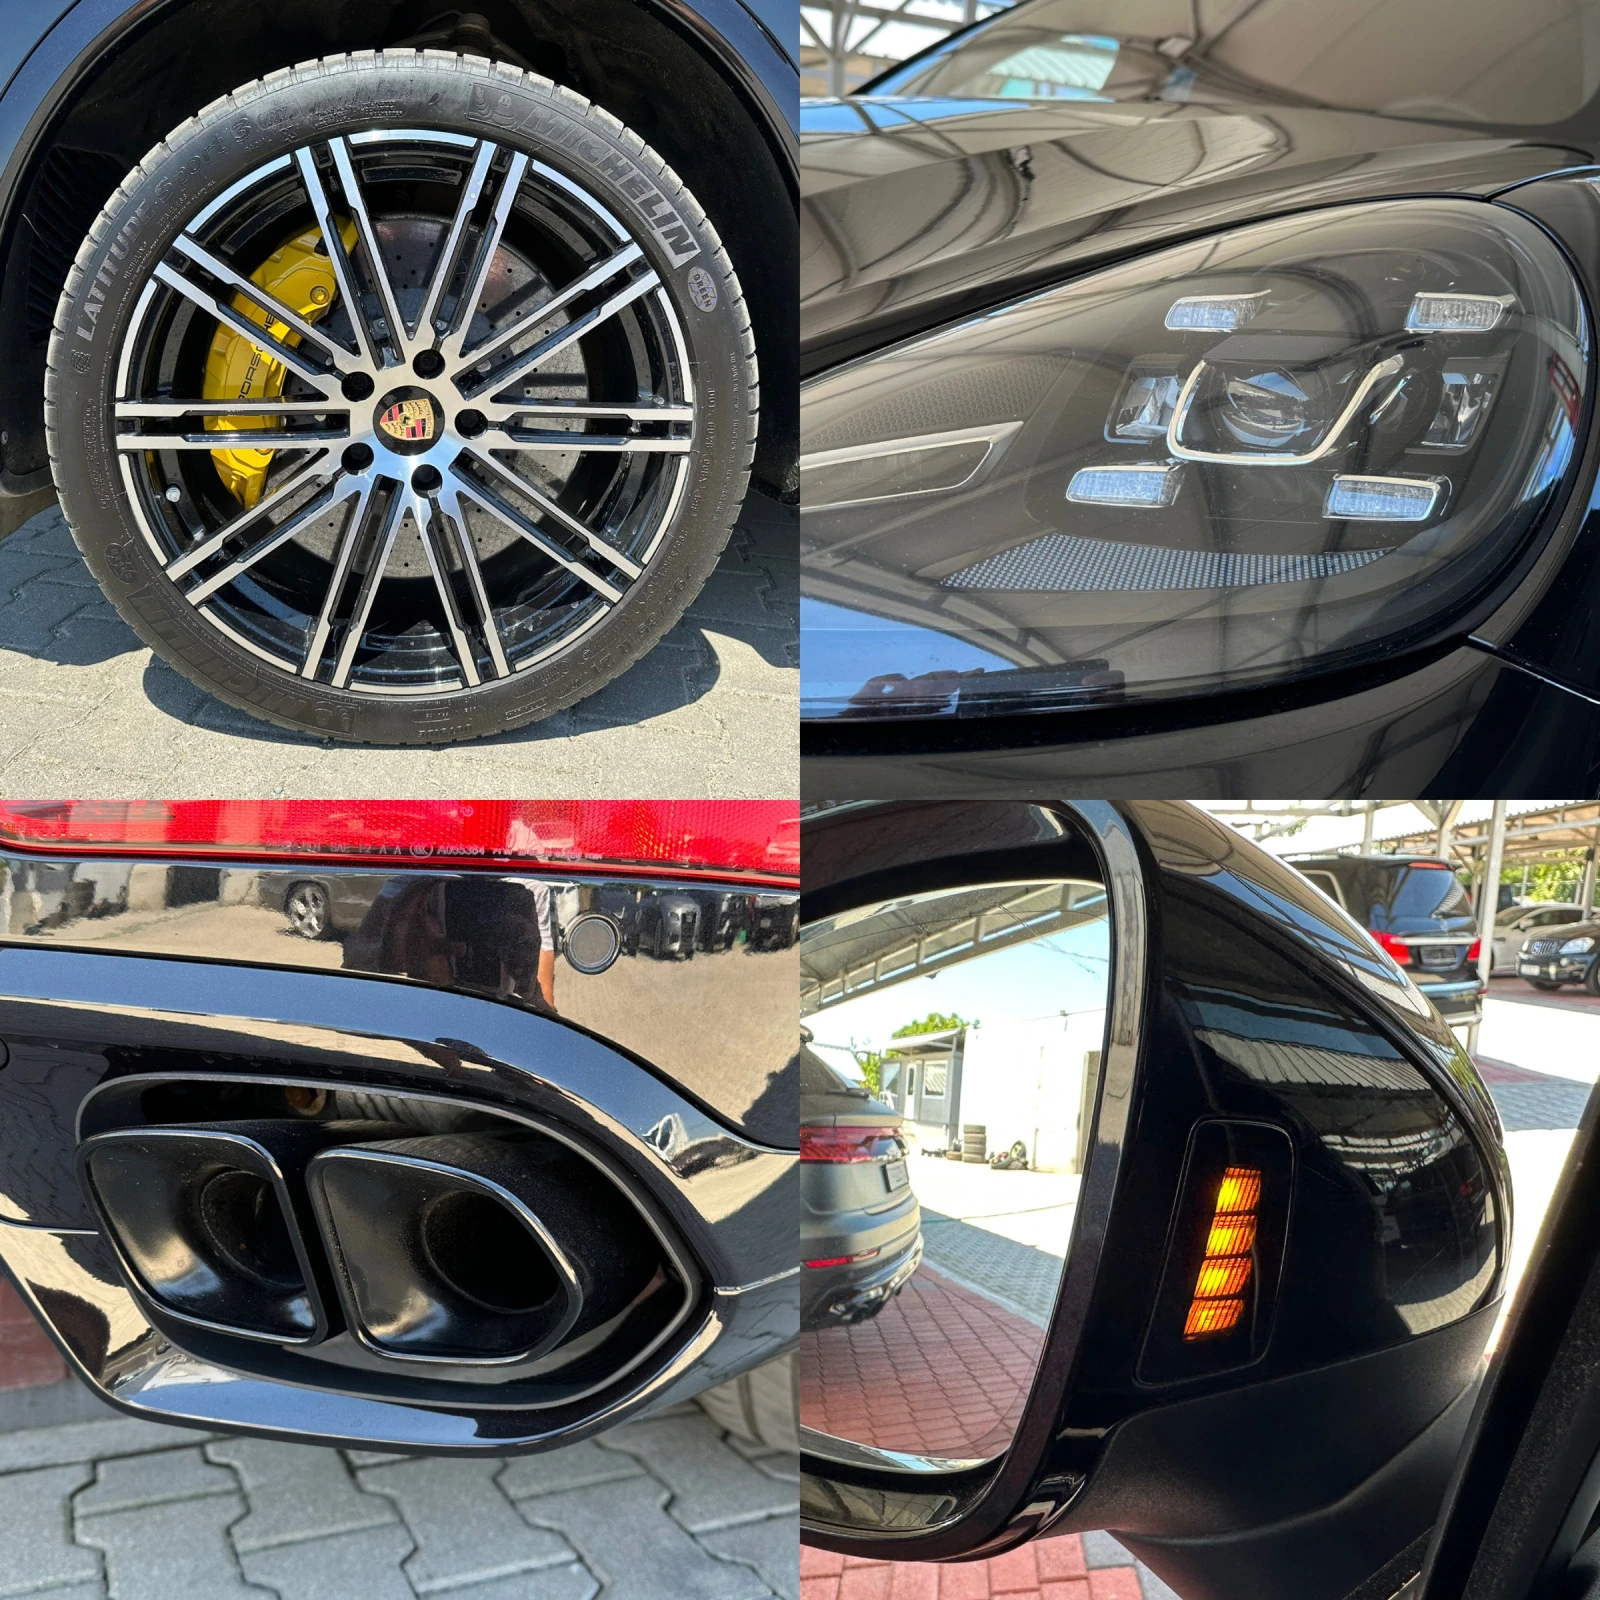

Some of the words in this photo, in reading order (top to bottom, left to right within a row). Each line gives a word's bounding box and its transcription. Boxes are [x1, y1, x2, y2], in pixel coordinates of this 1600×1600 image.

[76, 198, 156, 342] LATITUDE
[153, 132, 228, 205] Sport
[231, 117, 252, 145] 3
[519, 104, 699, 257] MICHELIN
[692, 271, 712, 308] GREEN
